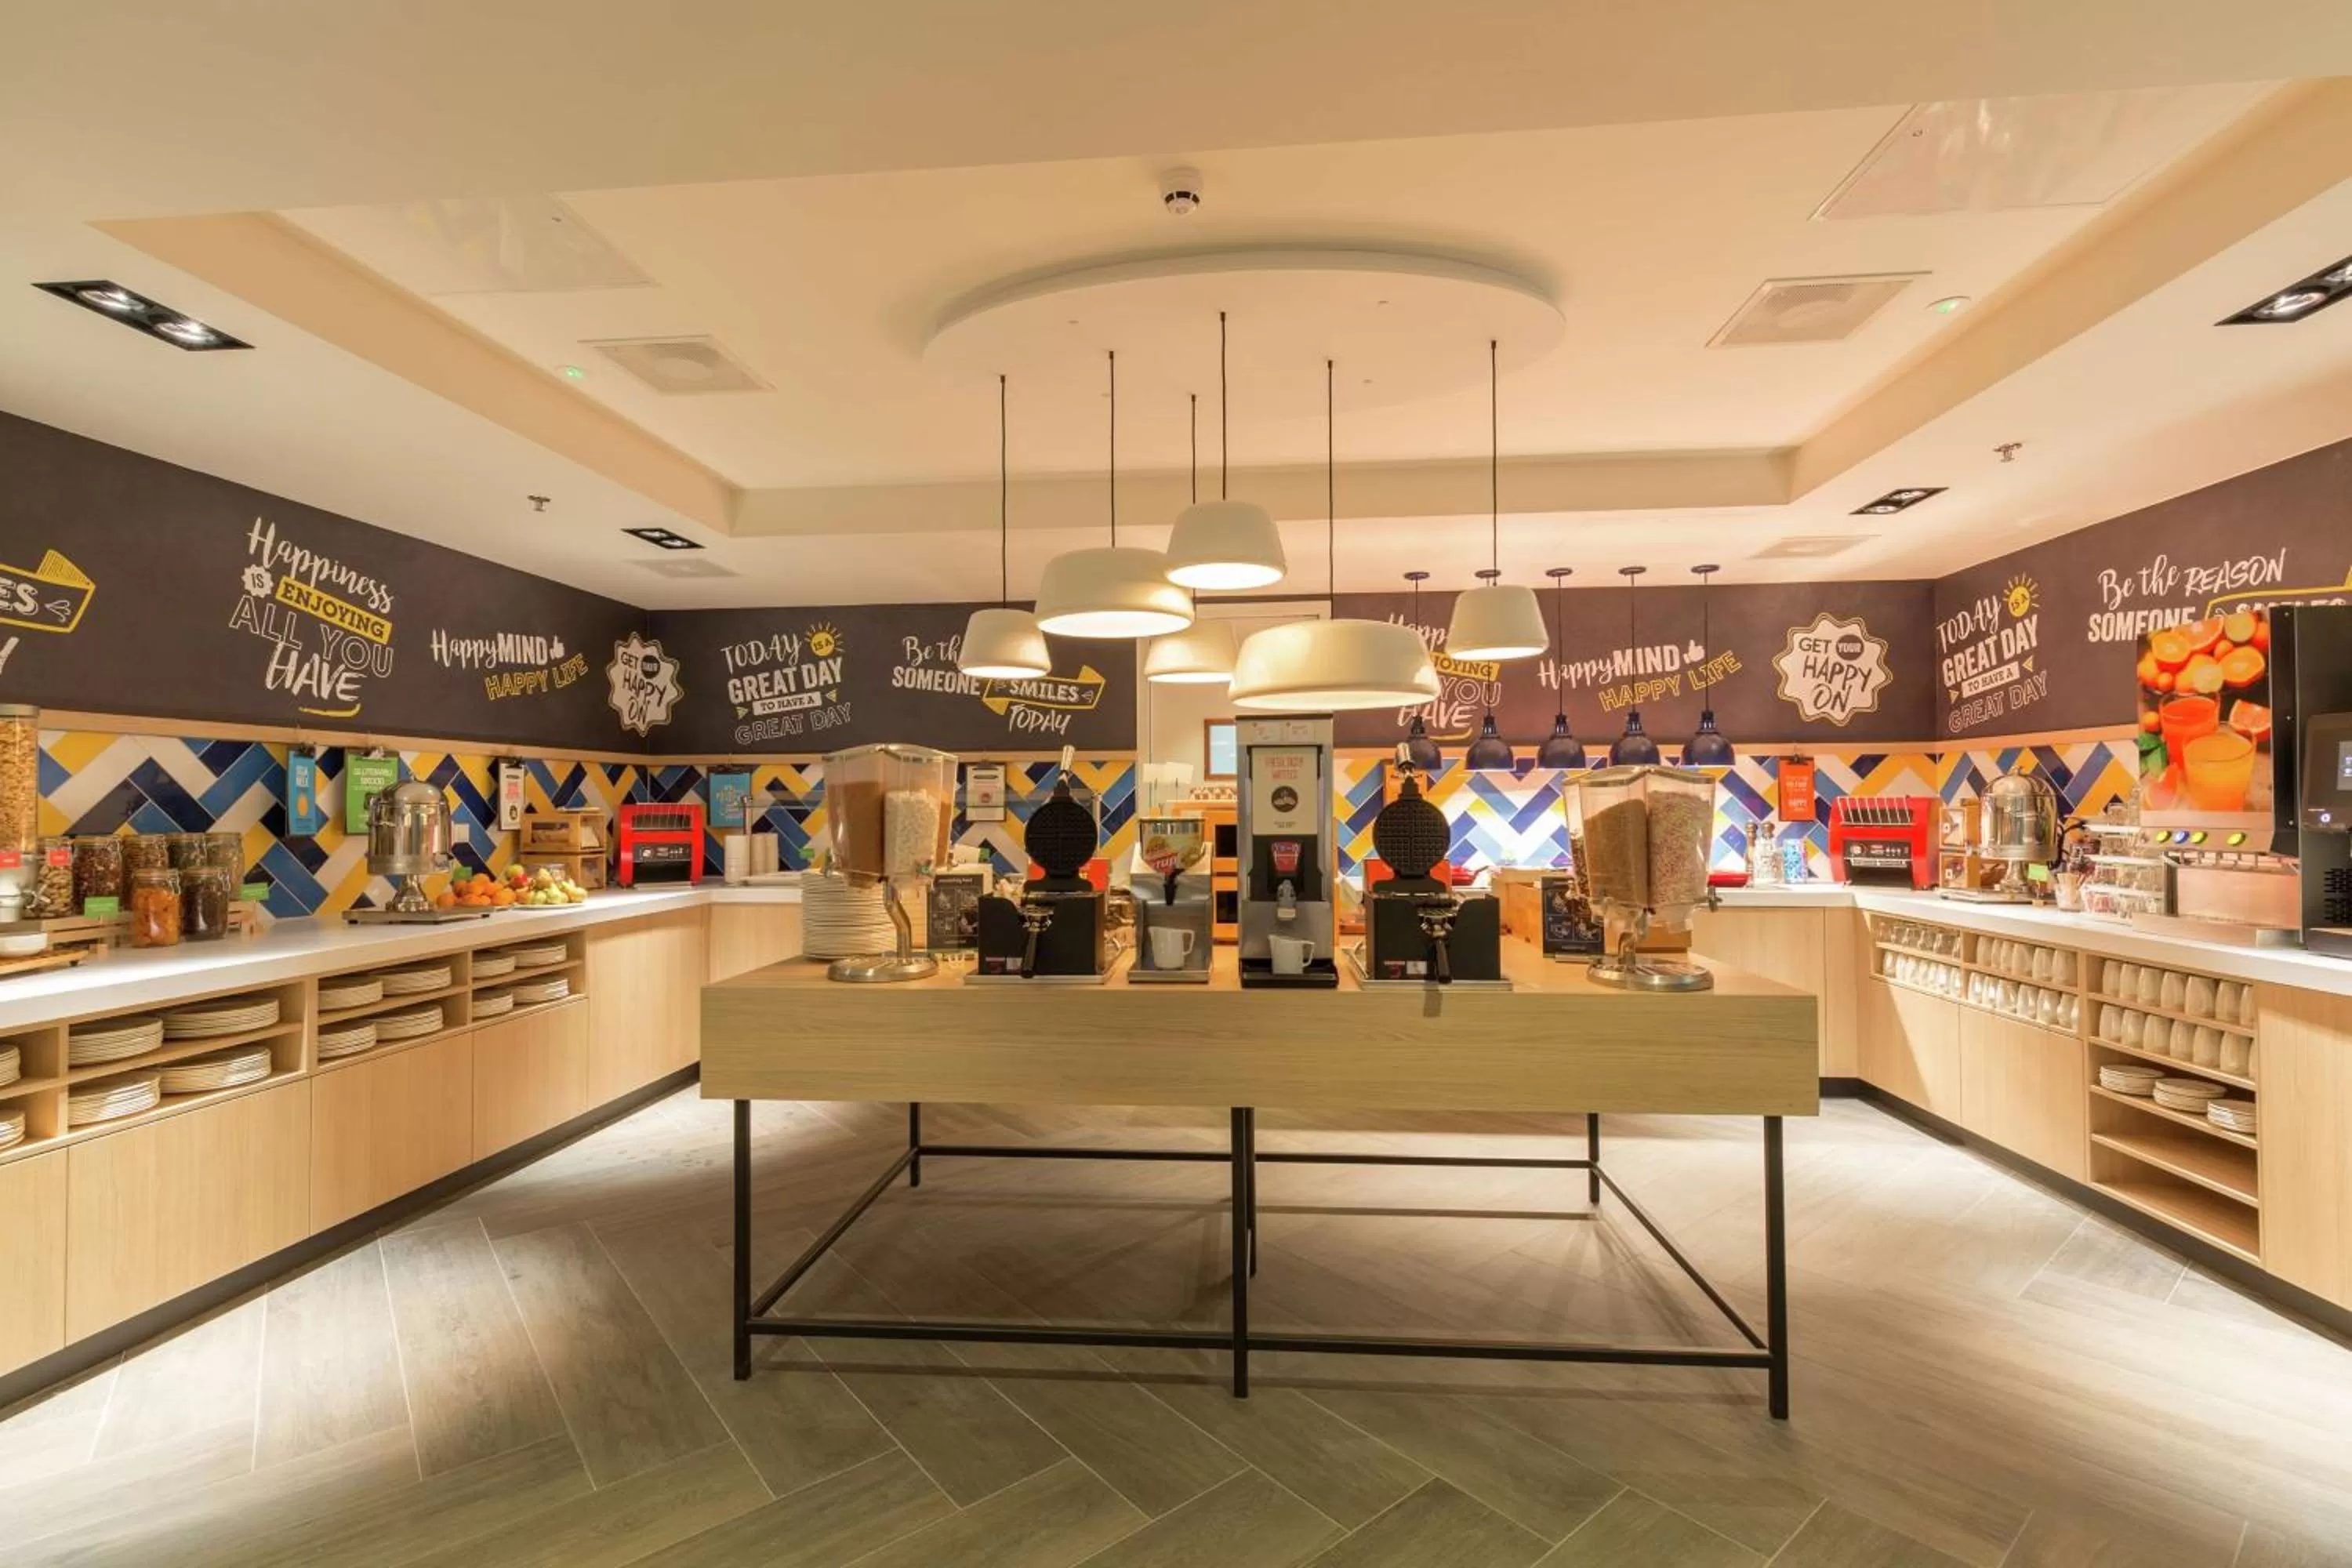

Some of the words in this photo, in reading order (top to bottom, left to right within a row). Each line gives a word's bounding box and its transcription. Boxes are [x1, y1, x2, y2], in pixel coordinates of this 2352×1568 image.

[246, 517, 394, 614] Happiness
[2097, 568, 2135, 610] Be
[2136, 554, 2180, 597] the
[2184, 547, 2286, 597] REASON
[251, 573, 265, 589] IS
[281, 582, 386, 639] ENJOYING
[1936, 595, 2002, 654] TODAY
[229, 594, 303, 650] ALL
[320, 624, 394, 678] YOU
[720, 633, 802, 674] TODAY
[813, 641, 824, 652] IS
[902, 636, 935, 666] Be
[936, 634, 960, 663] th
[1799, 637, 1831, 654] GET
[1838, 642, 1862, 653] YOUR
[1942, 635, 1998, 688] GREAT
[2001, 614, 2038, 660] DAY
[265, 641, 368, 702] HAVE
[485, 669, 548, 701] HAPPY
[552, 653, 588, 688] LIFE
[621, 652, 638, 670] GET
[728, 666, 797, 705] GREAT
[800, 656, 843, 689] DAY
[1599, 674, 1681, 712] HAPPY
[1687, 650, 1742, 690] LIFE
[1803, 655, 1872, 692] HAPPY
[1968, 681, 1980, 692] TO
[1981, 671, 2005, 688] HAVE
[2006, 669, 2014, 679] A
[622, 669, 667, 707] HAPPY
[760, 702, 775, 712] TO
[778, 697, 806, 710] HAVE
[892, 666, 980, 695] SOMEONE
[1009, 679, 1080, 702] SMILES
[1811, 683, 1853, 712] ON
[1948, 691, 2004, 734] GREAT
[2009, 670, 2048, 709] DAY
[628, 696, 650, 724] ON
[735, 713, 804, 745] GREAT
[810, 702, 851, 731] DAY
[1008, 704, 1071, 735] TODAY
